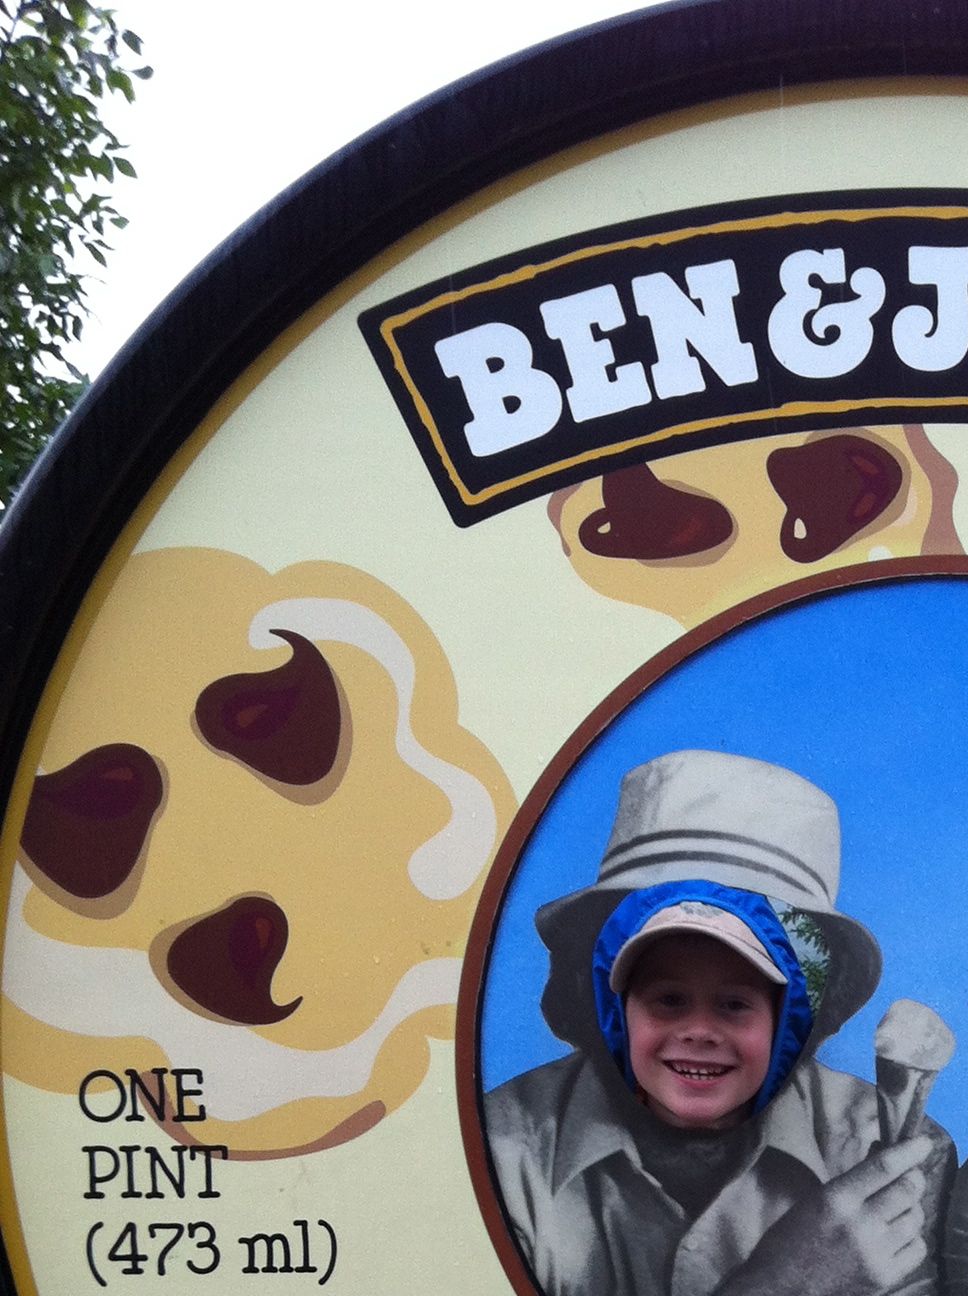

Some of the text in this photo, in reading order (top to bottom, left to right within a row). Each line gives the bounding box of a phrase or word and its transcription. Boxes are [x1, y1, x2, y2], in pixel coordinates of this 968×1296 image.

[433, 258, 759, 458] BEN
[78, 1067, 207, 1124] ONE
[81, 1144, 229, 1200] PINT
[86, 1219, 338, 1287] (473 ml)
